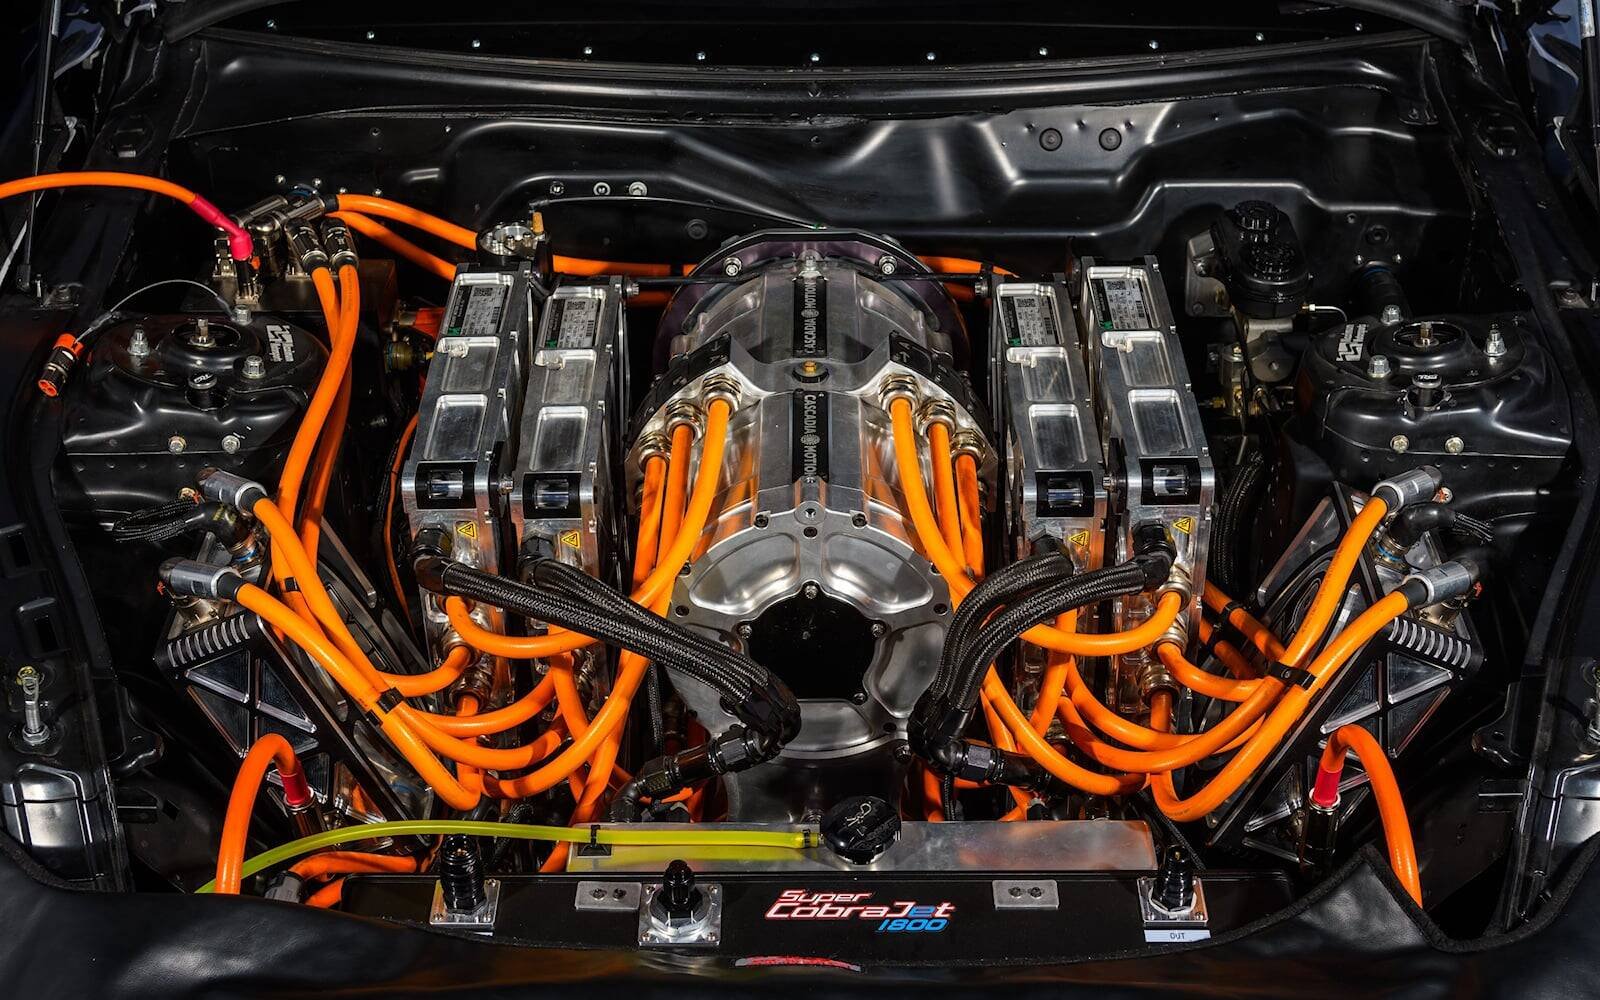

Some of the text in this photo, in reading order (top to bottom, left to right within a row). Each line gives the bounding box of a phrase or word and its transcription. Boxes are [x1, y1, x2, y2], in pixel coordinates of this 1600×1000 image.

[804, 282, 817, 354] CASCADIA MOTION
[804, 394, 817, 435] CASCADIA
[778, 889, 873, 905] Super
[765, 901, 956, 919] CobraJet
[877, 918, 950, 933] 1800
[1169, 932, 1185, 940] OUT
